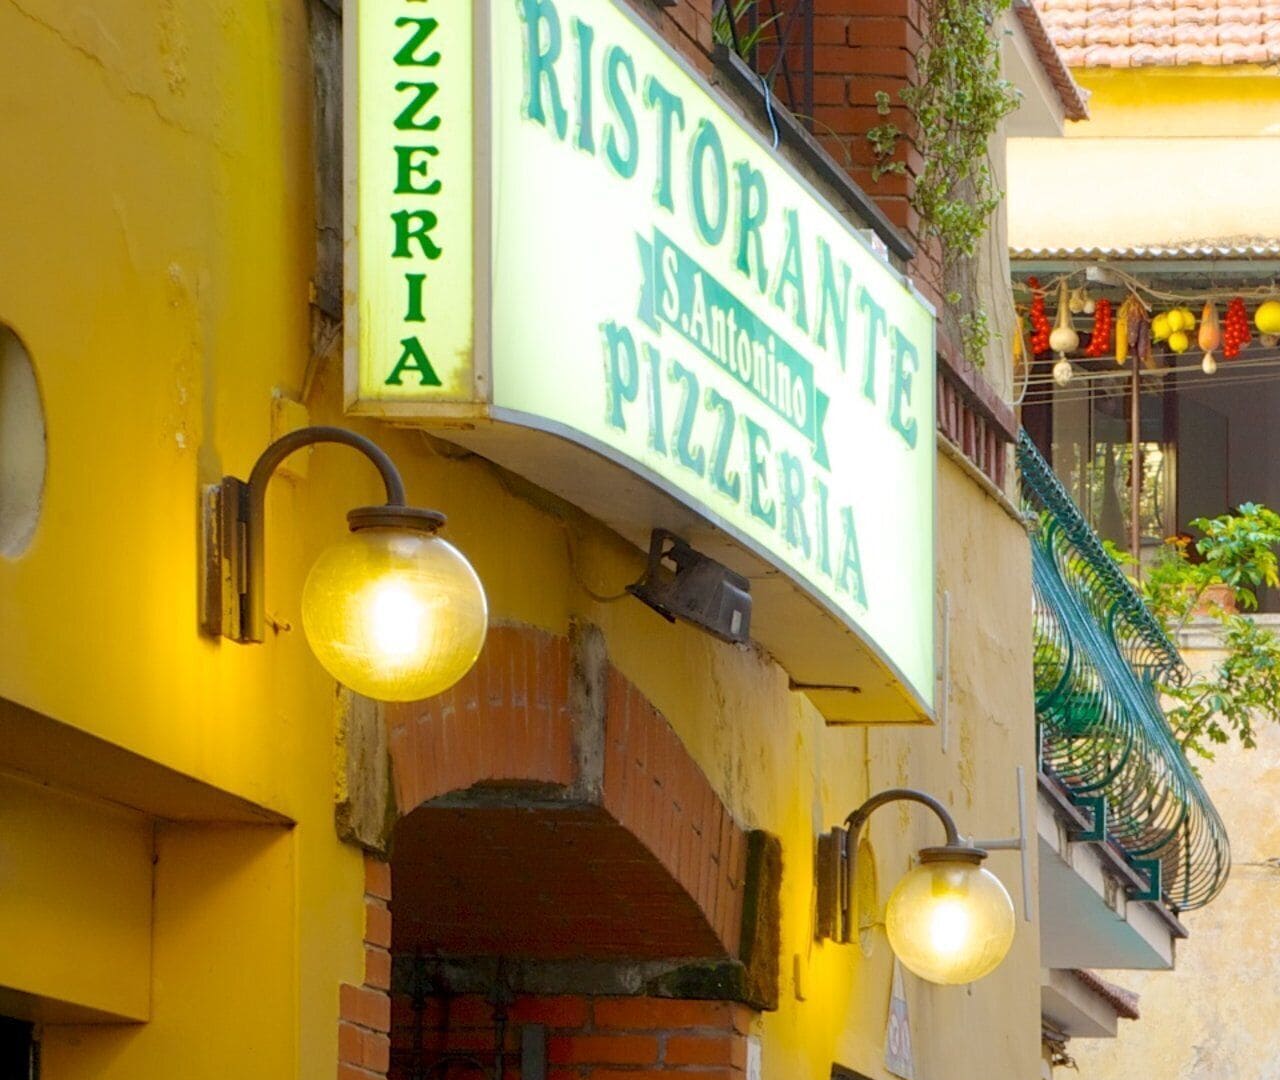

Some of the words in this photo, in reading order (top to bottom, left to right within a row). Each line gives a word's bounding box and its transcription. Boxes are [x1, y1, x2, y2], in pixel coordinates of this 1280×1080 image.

[384, 0, 442, 386] ZZERIA
[519, 0, 920, 449] RISTORANTE
[660, 244, 808, 429] S.Antonino
[599, 318, 869, 611] PIZZERIA
